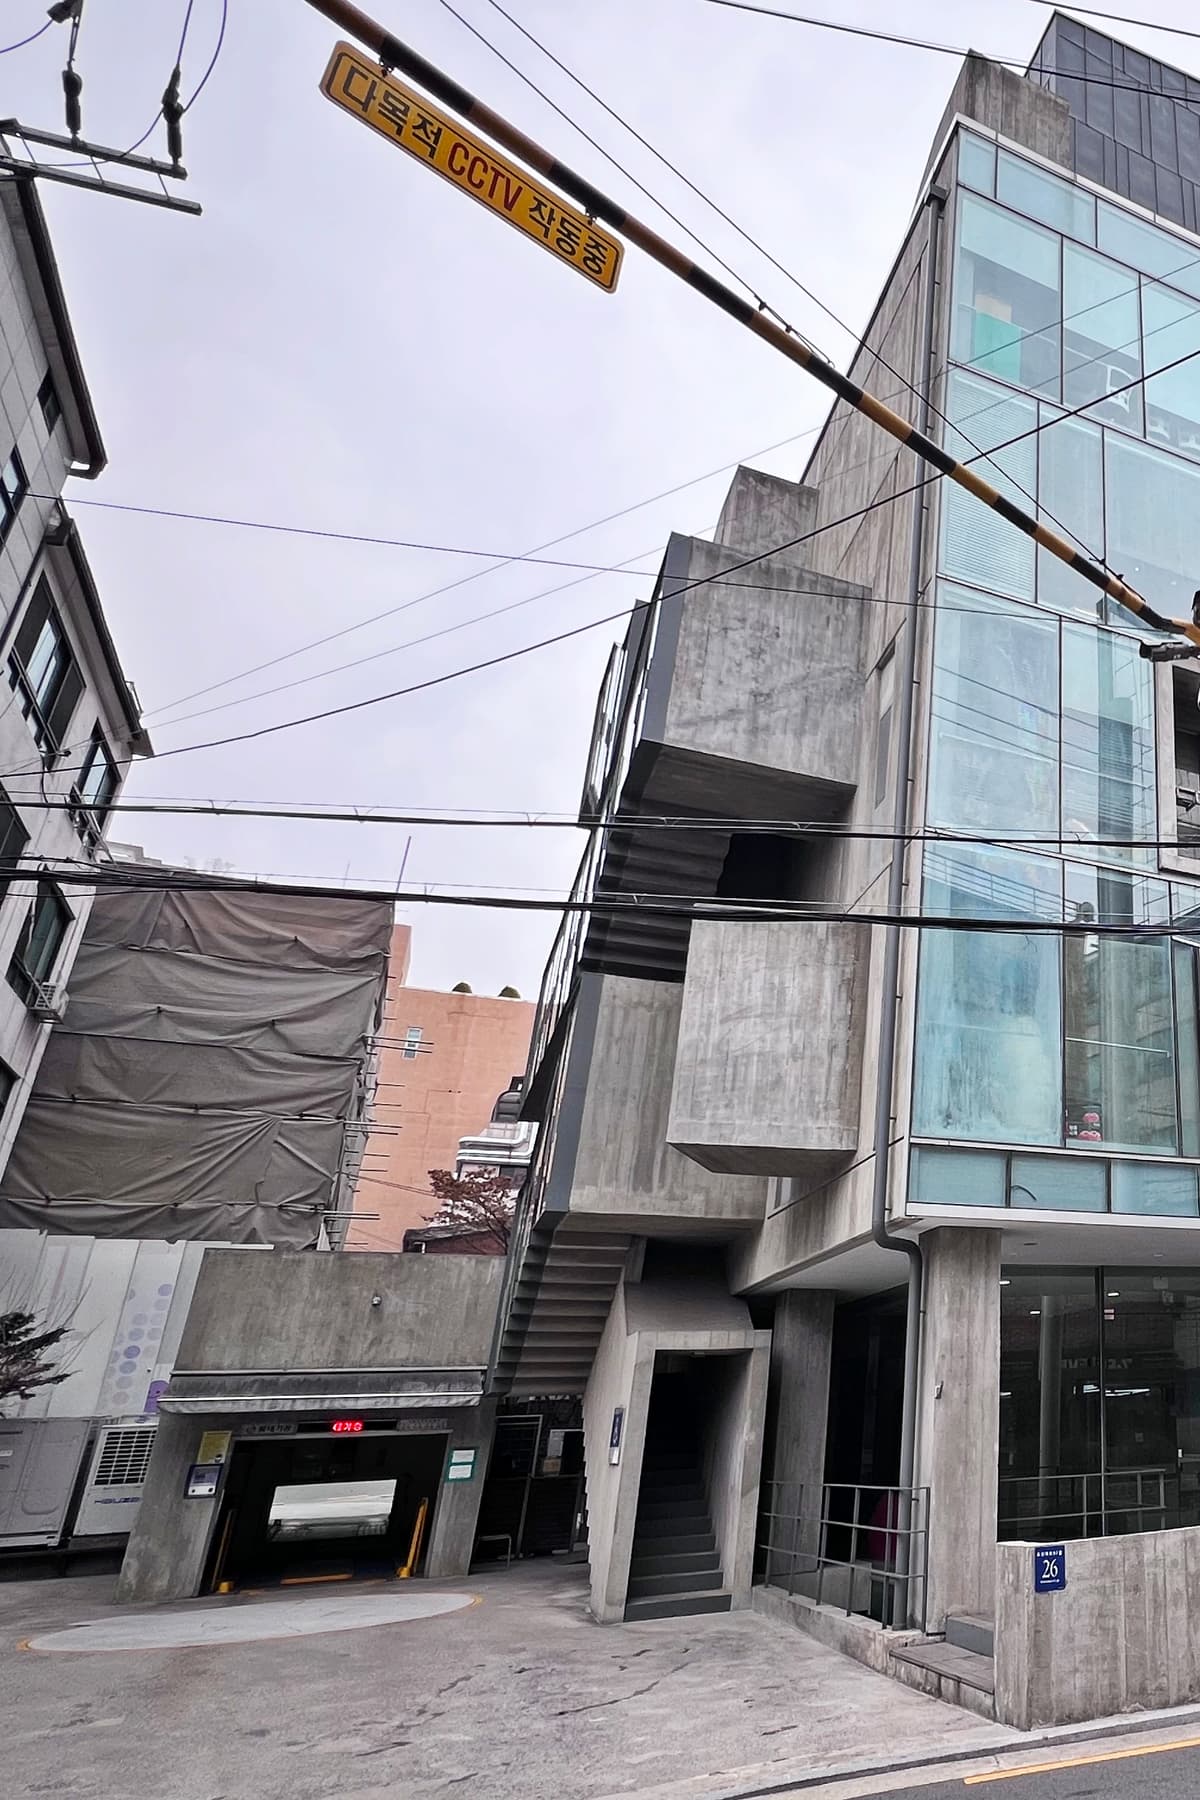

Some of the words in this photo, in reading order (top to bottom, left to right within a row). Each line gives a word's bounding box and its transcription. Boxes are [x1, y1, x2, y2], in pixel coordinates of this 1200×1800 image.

[342, 66, 442, 160] 다목적
[448, 142, 523, 211] CCTV
[529, 196, 609, 275] 작동중
[1042, 1559, 1058, 1578] 26
